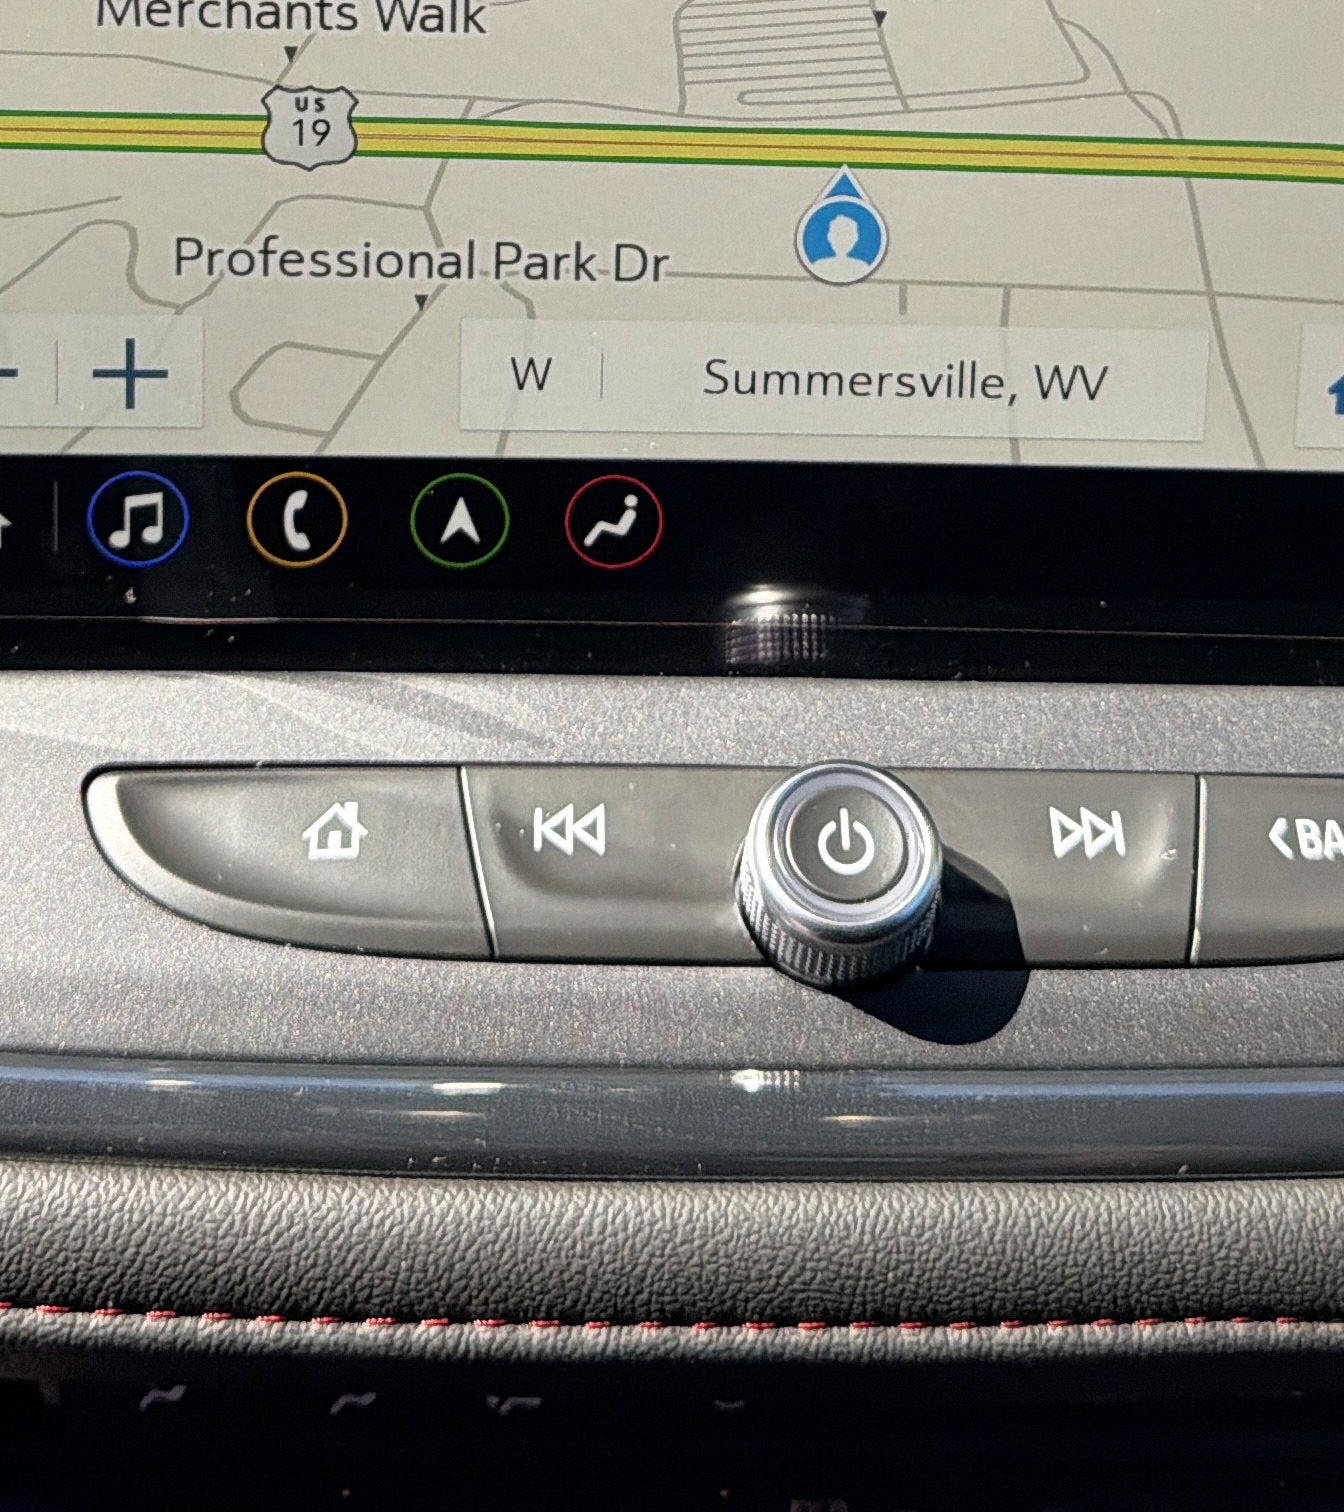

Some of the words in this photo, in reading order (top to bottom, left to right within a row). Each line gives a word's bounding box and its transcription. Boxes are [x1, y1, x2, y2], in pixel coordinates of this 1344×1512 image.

[294, 95, 326, 113] US
[291, 119, 332, 147] 19
[175, 235, 475, 279] Professional
[494, 241, 598, 282] Park
[614, 244, 670, 283] Dr
[510, 356, 553, 391] W
[703, 358, 1019, 407] Summersville,
[1035, 364, 1109, 401] WV
